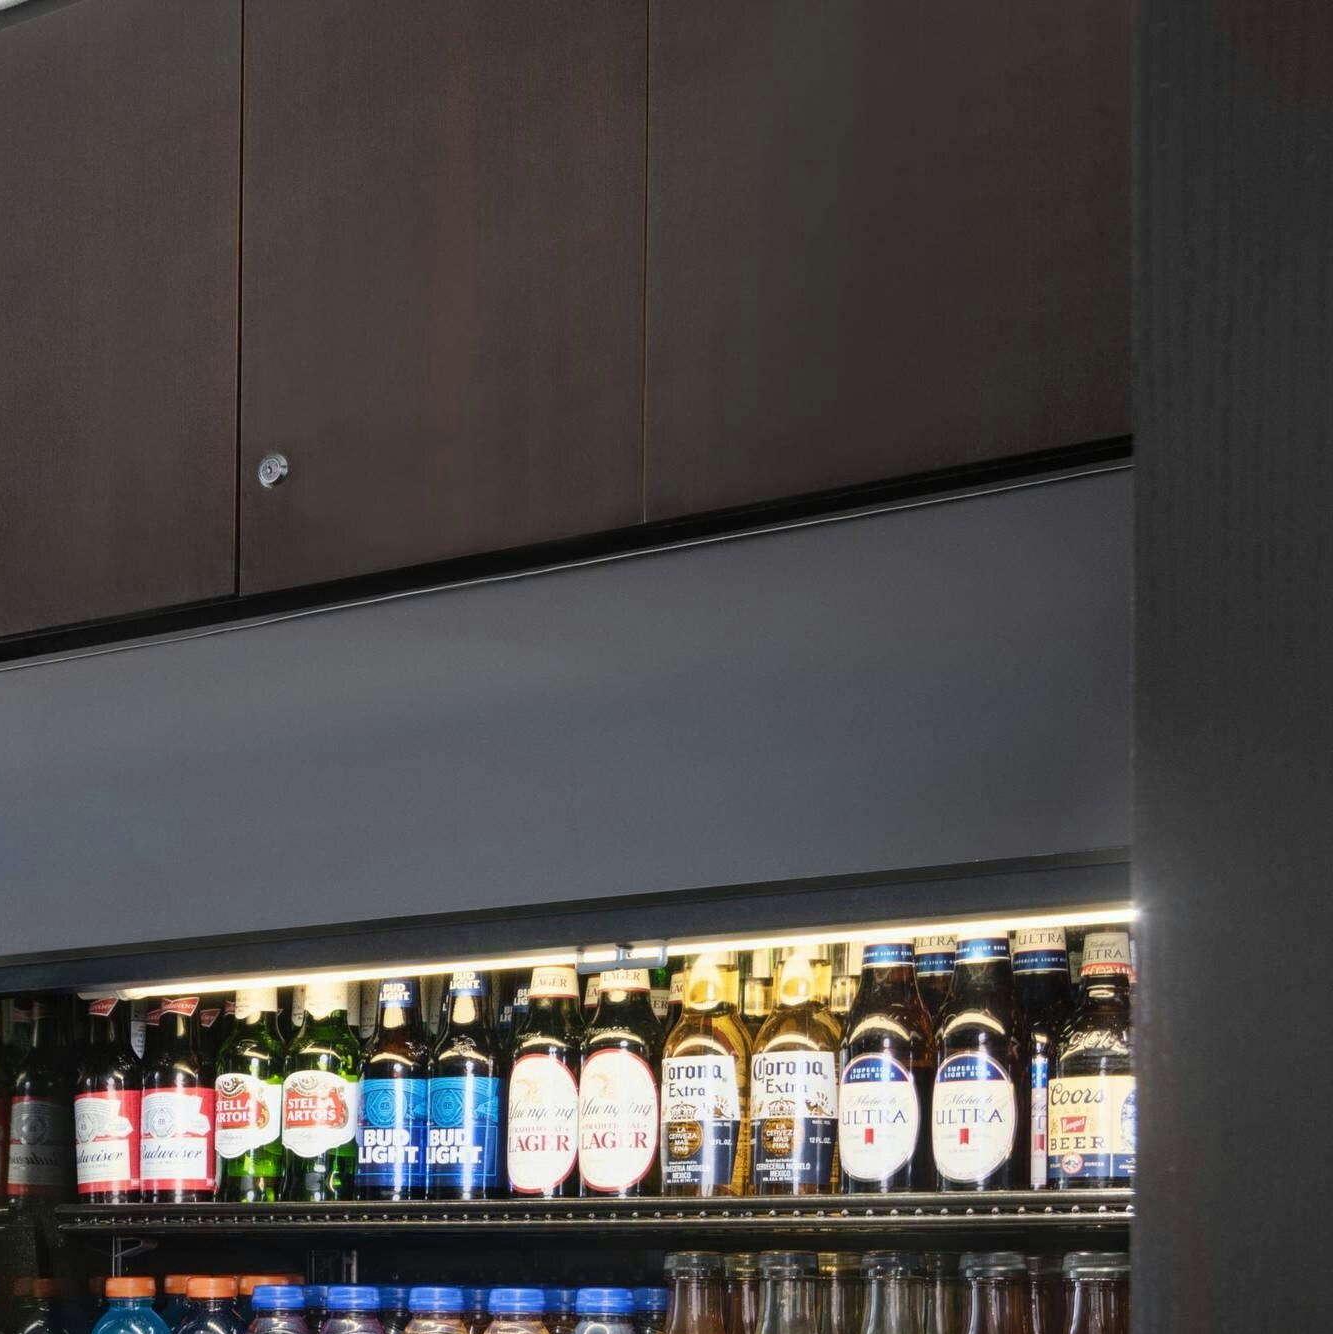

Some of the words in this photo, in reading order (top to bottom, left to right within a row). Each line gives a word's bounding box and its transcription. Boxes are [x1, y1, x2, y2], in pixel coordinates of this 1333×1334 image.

[1018, 932, 1064, 946] ULTRA
[382, 983, 406, 994] BUD
[449, 979, 482, 990] LIGHT
[379, 991, 412, 1002] LIGHT
[753, 1056, 824, 1084] Corona
[668, 1081, 706, 1097] Extra
[1050, 1082, 1104, 1107] Coors
[216, 1099, 252, 1112] STELLA
[287, 1099, 336, 1110] STELLA
[216, 1111, 255, 1123] ARTOIS
[287, 1110, 337, 1122] ARTOIS
[363, 1128, 410, 1146] BUD
[429, 1128, 470, 1146] BUD
[1050, 1136, 1105, 1151] BEER
[76, 1148, 124, 1164] dweiser
[358, 1146, 418, 1164] LIGHT
[426, 1146, 482, 1164] LIGHT
